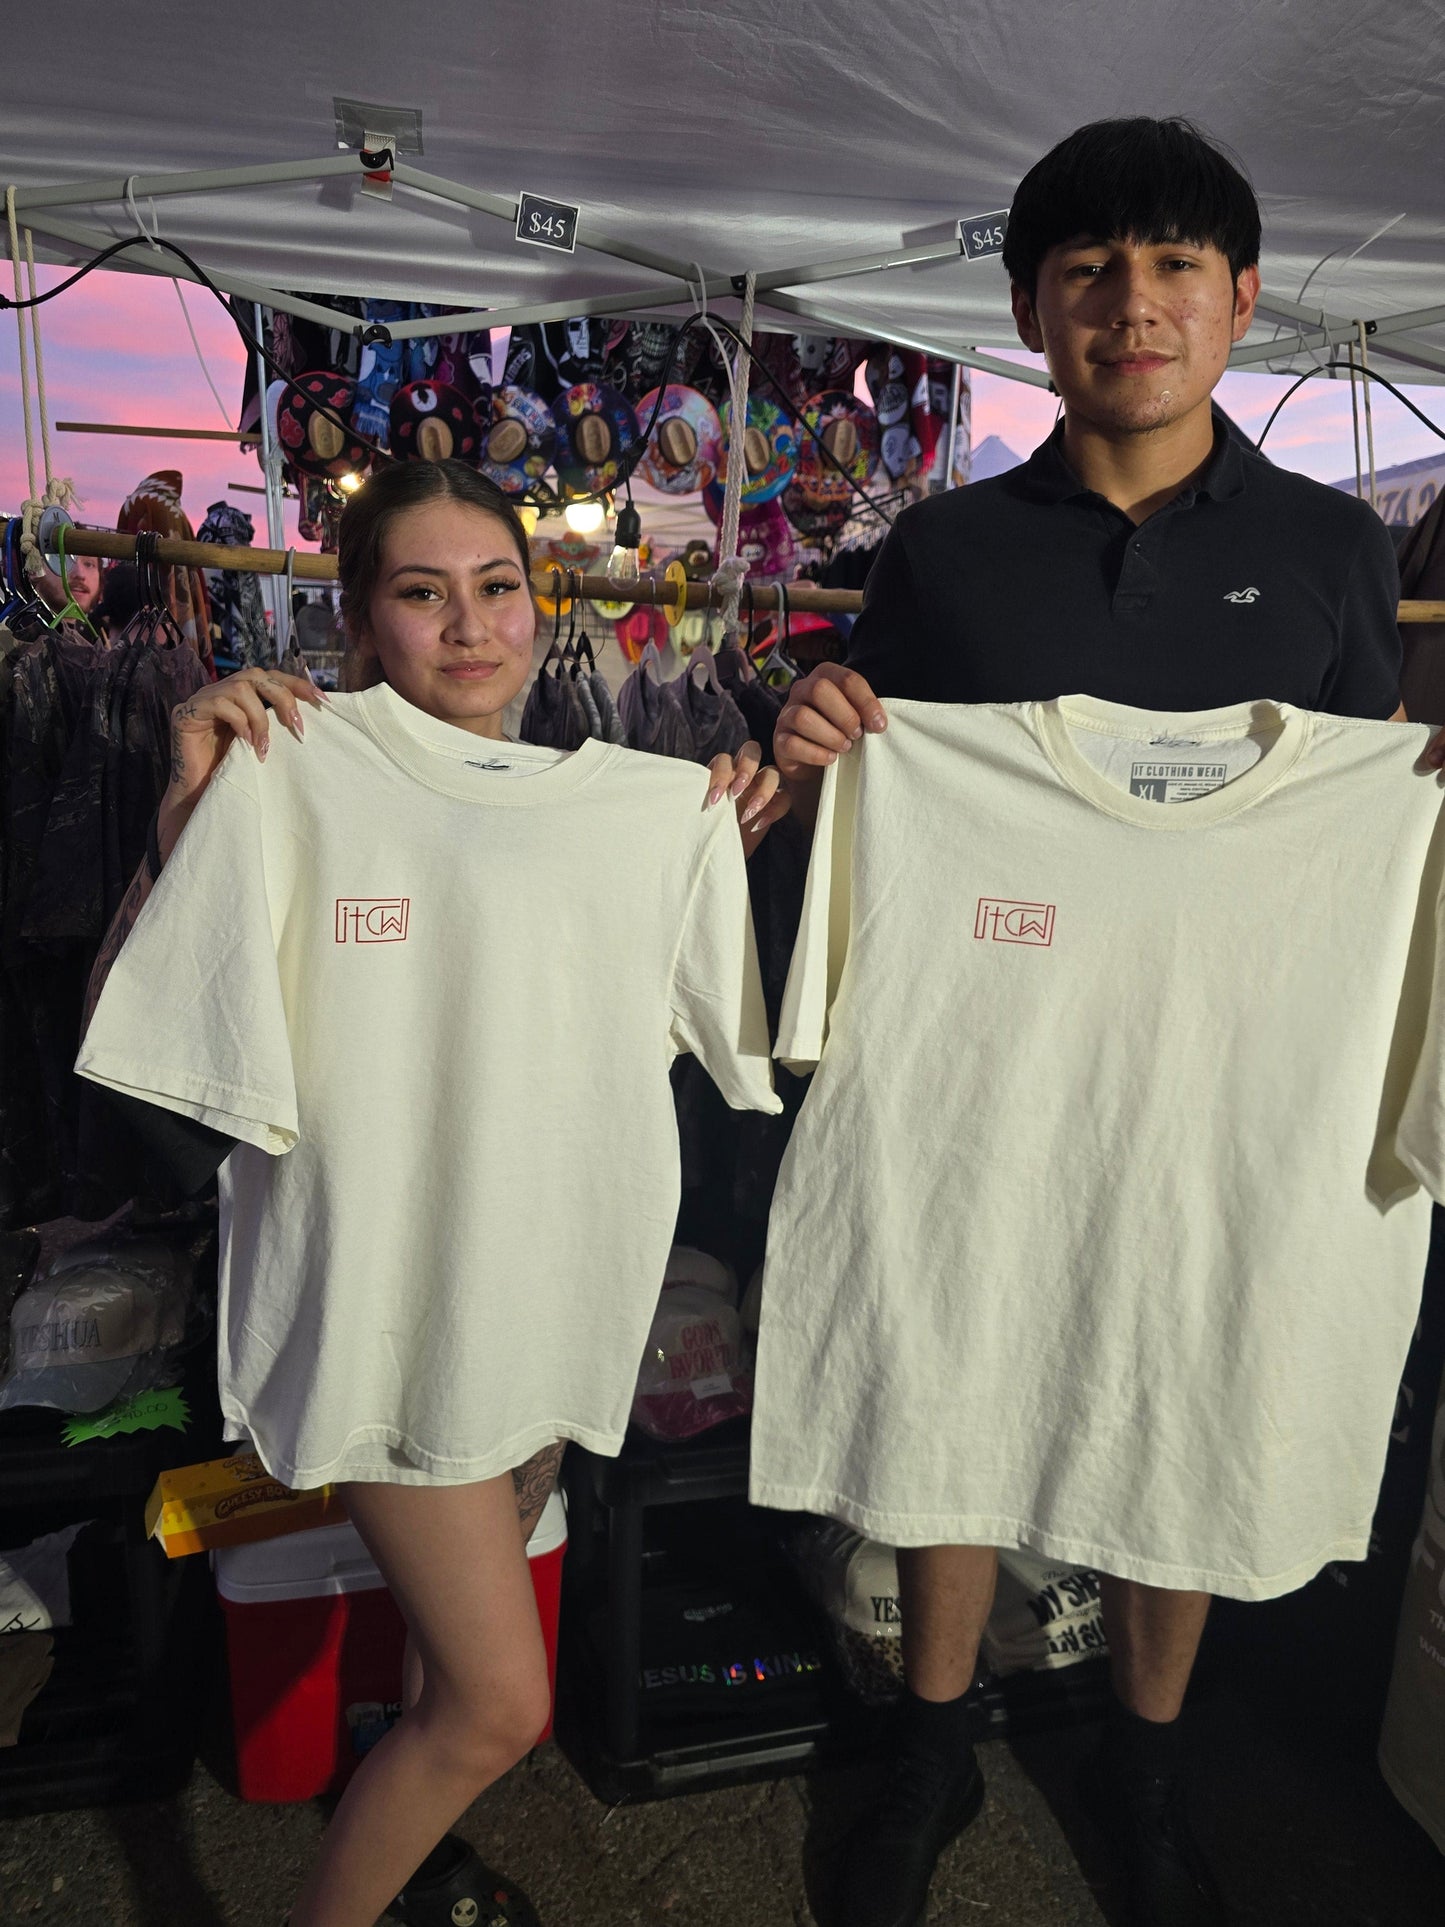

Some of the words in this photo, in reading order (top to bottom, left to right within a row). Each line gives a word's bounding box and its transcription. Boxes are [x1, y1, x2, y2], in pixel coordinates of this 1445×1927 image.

[529, 211, 566, 239] $45
[972, 226, 1004, 250] $45
[1134, 765, 1144, 776] IT
[1146, 766, 1194, 777] CLOTHING
[1197, 767, 1224, 777] WEAR
[1139, 784, 1157, 801] XL
[639, 1663, 716, 1689] ESUS
[721, 1662, 748, 1688] IS
